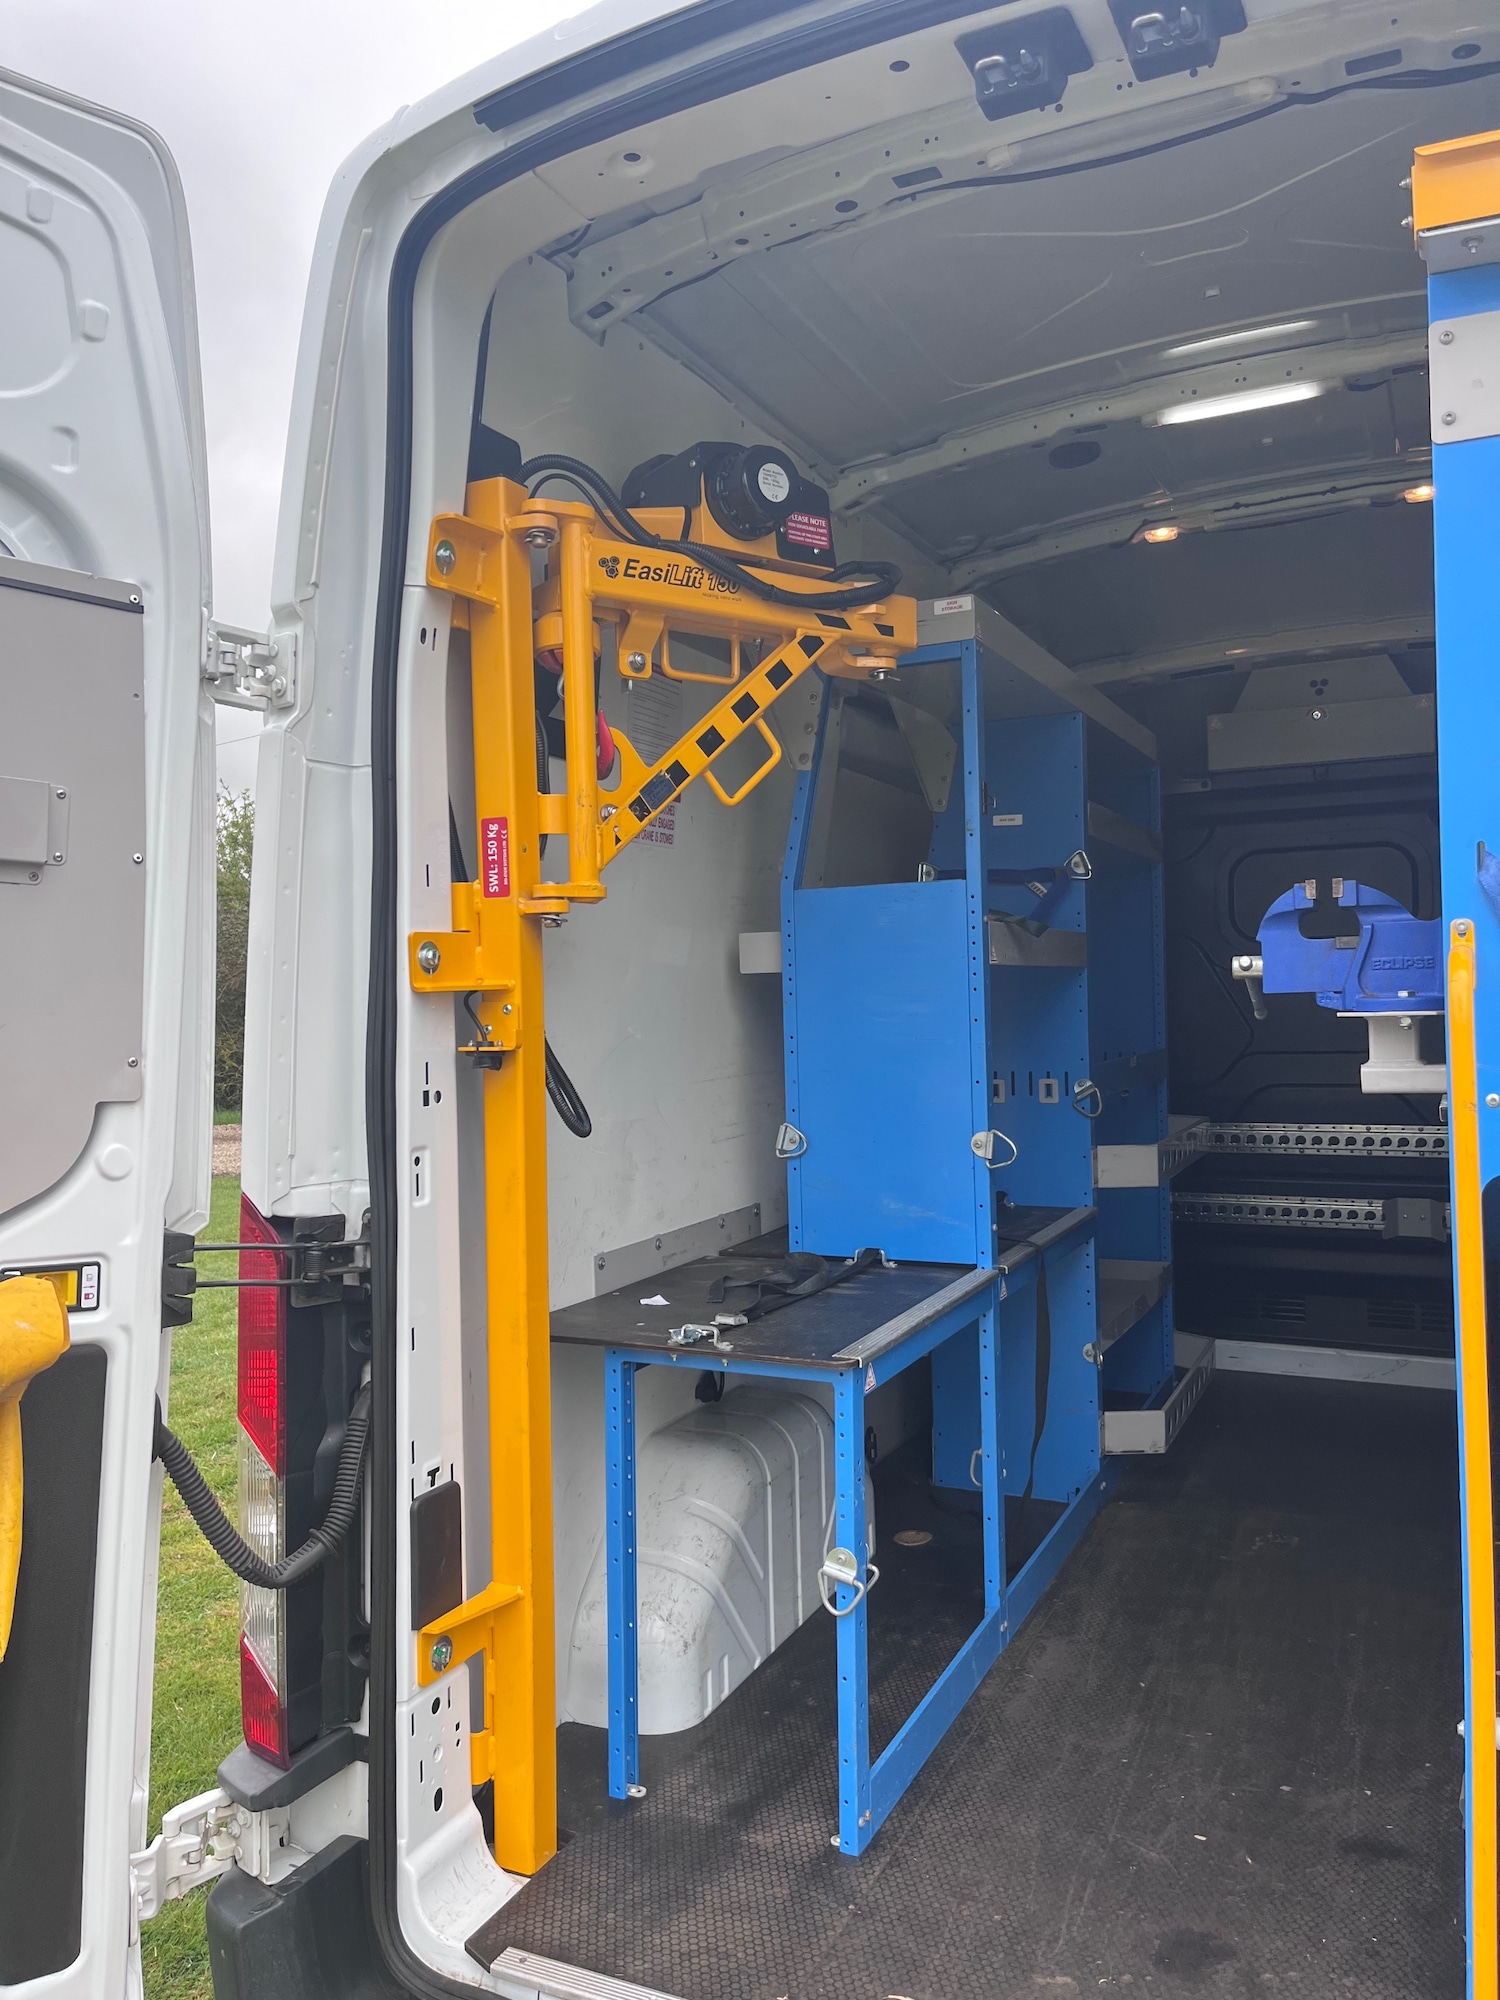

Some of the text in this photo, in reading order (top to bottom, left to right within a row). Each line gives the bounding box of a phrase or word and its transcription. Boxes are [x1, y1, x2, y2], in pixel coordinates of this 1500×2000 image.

[810, 518, 826, 527] NOTE
[622, 558, 704, 589] EasiLift
[487, 823, 499, 892] SWL: 150 Kg
[1371, 956, 1436, 970] ECLIPSE
